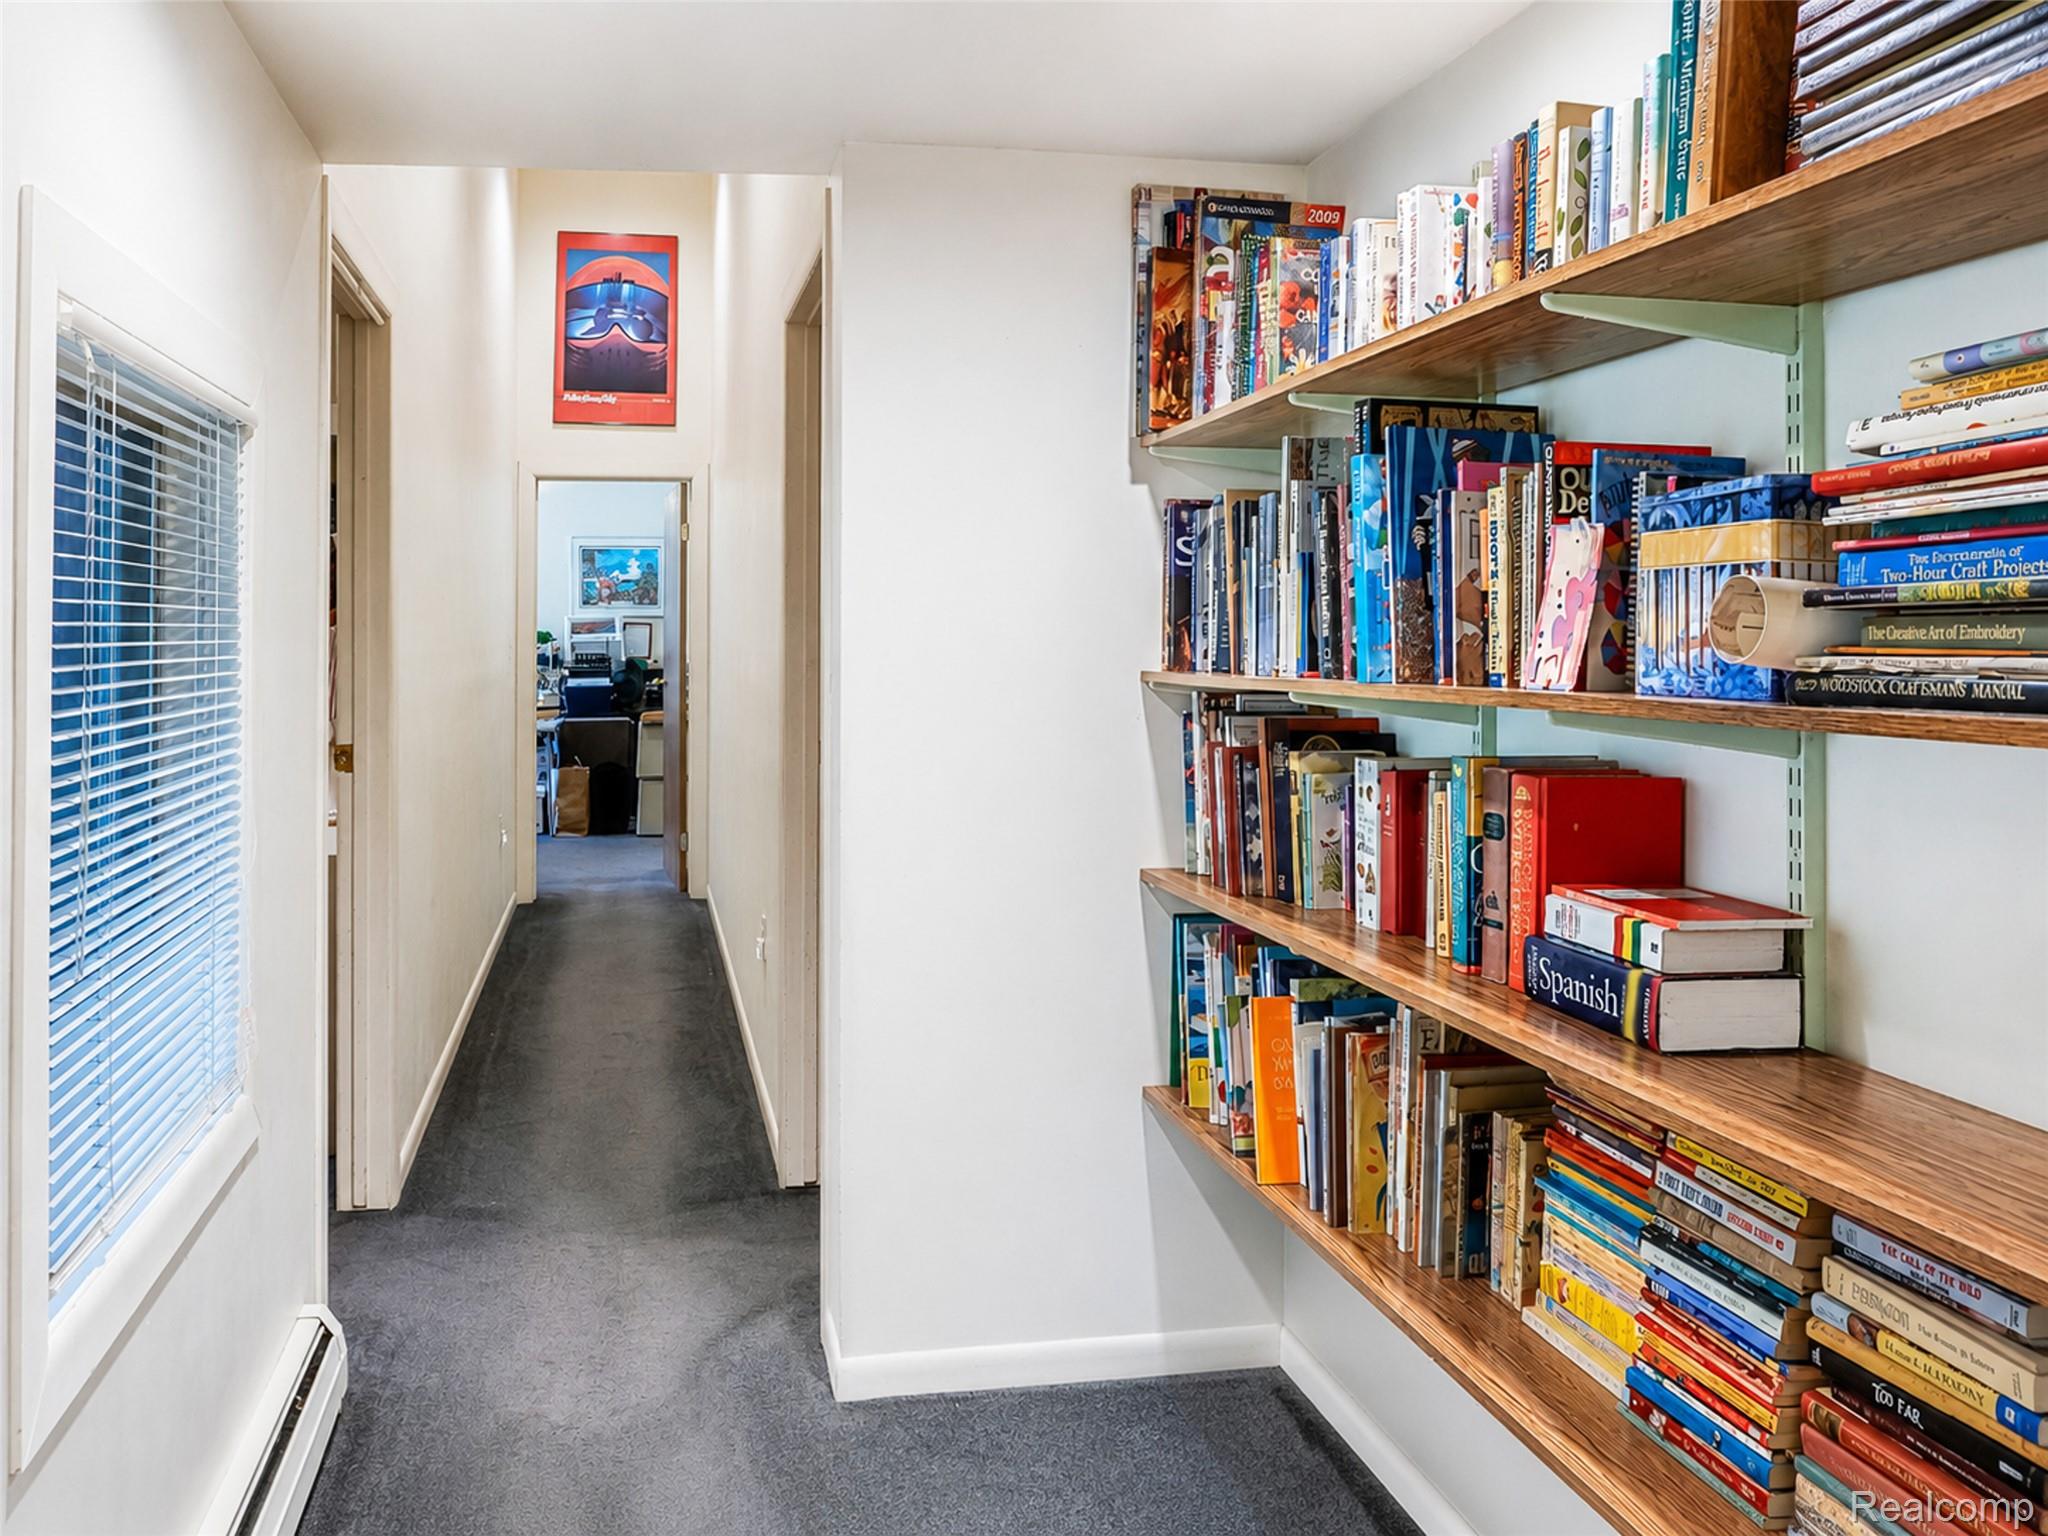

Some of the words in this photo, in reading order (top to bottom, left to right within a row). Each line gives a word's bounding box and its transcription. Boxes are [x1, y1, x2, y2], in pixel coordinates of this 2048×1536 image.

[1307, 208, 1341, 225] 2009
[1880, 564, 1947, 583] Two-Hour
[1951, 560, 1988, 579] Craft
[1868, 625, 1885, 640] The
[1886, 624, 1928, 640] Creative
[1929, 625, 1945, 640] Art
[1945, 624, 1958, 640] of
[1959, 623, 2026, 644] Embroidery
[1820, 677, 1887, 694] WOODSTOCK
[1971, 683, 2026, 700] MANUAL
[1539, 956, 1620, 1018] Spanish
[1881, 1241, 1898, 1259] THE
[1900, 1249, 1921, 1271] CALL
[1923, 1262, 1937, 1276] OF
[1939, 1270, 1956, 1288] THE
[1958, 1279, 1981, 1301] WILD
